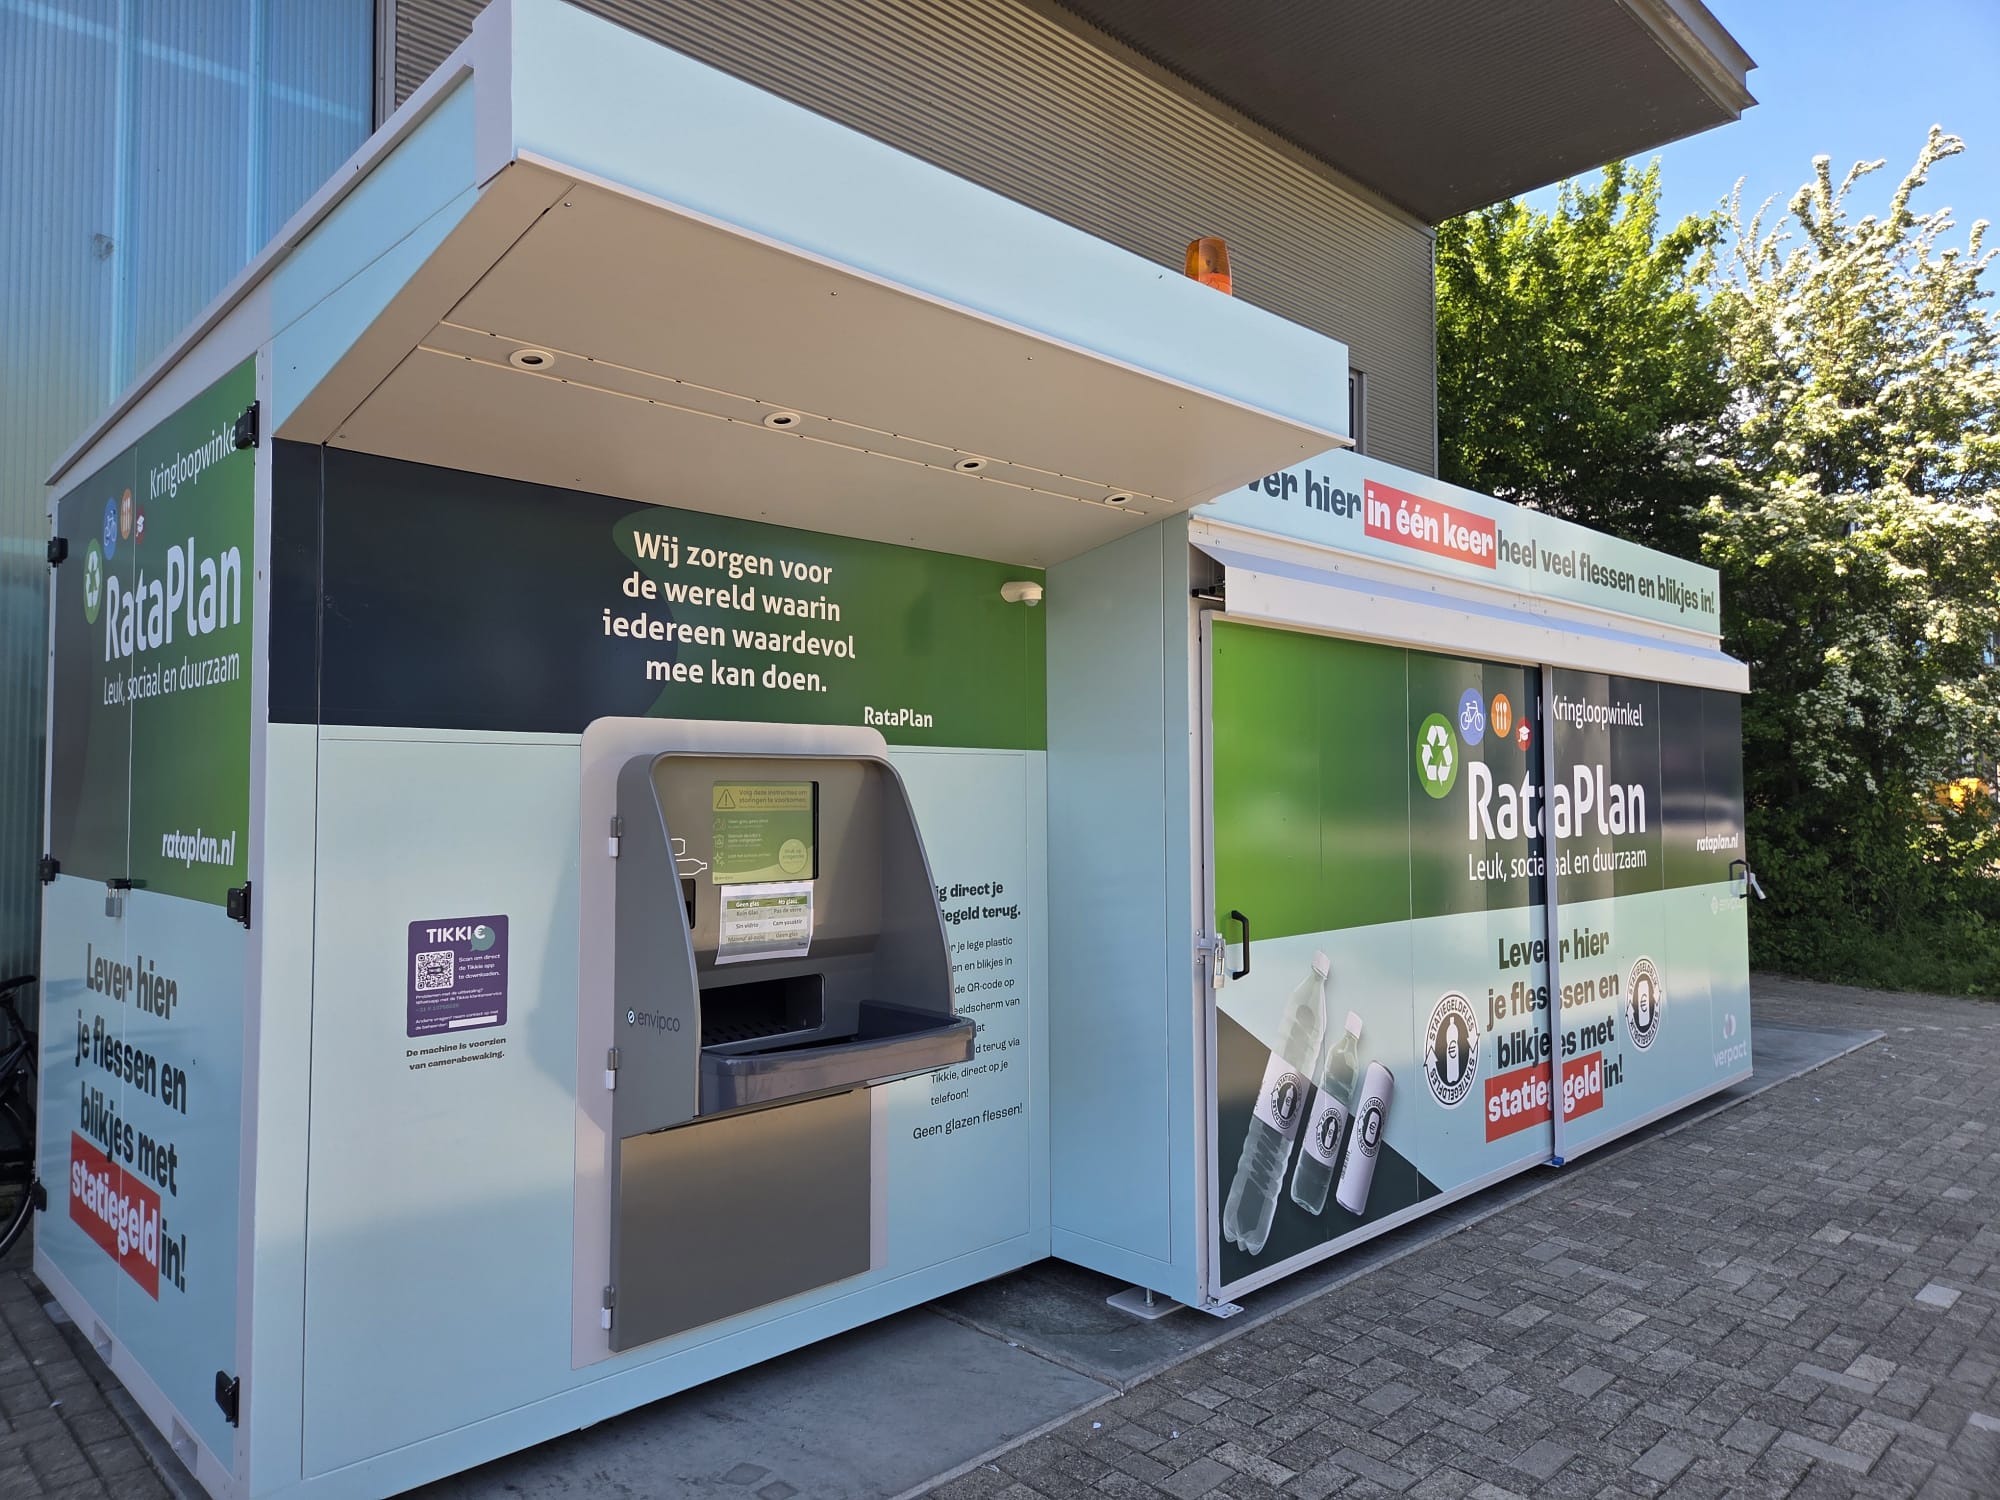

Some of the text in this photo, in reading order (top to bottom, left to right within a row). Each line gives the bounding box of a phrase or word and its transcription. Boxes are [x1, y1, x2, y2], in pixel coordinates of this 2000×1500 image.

[150, 414, 241, 500] Kringloopwinke
[633, 531, 833, 584] Wij zorgen voor
[1305, 469, 1361, 519] hier
[1367, 490, 1391, 530] in
[1396, 500, 1438, 543] één
[1443, 512, 1494, 557] keer
[1498, 529, 1536, 569] heel
[1541, 550, 1576, 579] veel
[1579, 552, 1635, 594] flessen
[1638, 576, 1655, 599] en
[1657, 575, 1699, 613] blikjes
[1700, 588, 1715, 614] in!
[105, 537, 241, 662] RataPlan
[622, 571, 841, 622] de wereld waarin
[602, 609, 856, 660] iedereen waardevol
[103, 651, 240, 706] Leuk, sociaal en duurzaam
[646, 658, 828, 693] mee kan doen.
[864, 706, 934, 729] RataPlan
[1552, 695, 1644, 730] Kringloopwinkel
[162, 830, 237, 868] rataplan.nl
[1697, 833, 1739, 851] rataplan.nl
[1469, 853, 1507, 882] Leuk,
[1574, 854, 1590, 873] en
[1593, 847, 1647, 870] duurzaam
[950, 883, 990, 897] direct
[991, 881, 1003, 898] je
[982, 904, 1021, 919] terug.
[956, 941, 965, 953] je
[966, 940, 983, 951] lege
[985, 937, 1013, 949] plastic
[1573, 927, 1610, 960] hier
[86, 943, 177, 1020] Lever hier
[964, 962, 975, 971] en
[976, 958, 1003, 970] blikjes
[1005, 957, 1013, 965] in
[954, 979, 1015, 994] de QR-code op
[1005, 998, 1020, 1007] van
[1487, 988, 1506, 1031] je
[1598, 973, 1620, 999] en
[637, 1010, 680, 1035] envipco
[1430, 999, 1474, 1041] STATIEGELDFLES
[1580, 1015, 1614, 1046] met
[75, 1010, 187, 1114] je flessen en
[406, 1037, 506, 1058] De machine is voorzien
[409, 1050, 505, 1070] van camerabewaking.
[982, 1041, 1006, 1051] terug
[1008, 1038, 1020, 1047] via
[1713, 1040, 1747, 1068] verpact
[931, 1060, 1008, 1084] Tikkie, direct op je
[1603, 1054, 1623, 1089] in!
[930, 1088, 969, 1106] telefoon!
[913, 1102, 1023, 1139] Geen glazen flessen!
[81, 1081, 177, 1197] blikjes met
[72, 1159, 187, 1293] statiegeld in!
